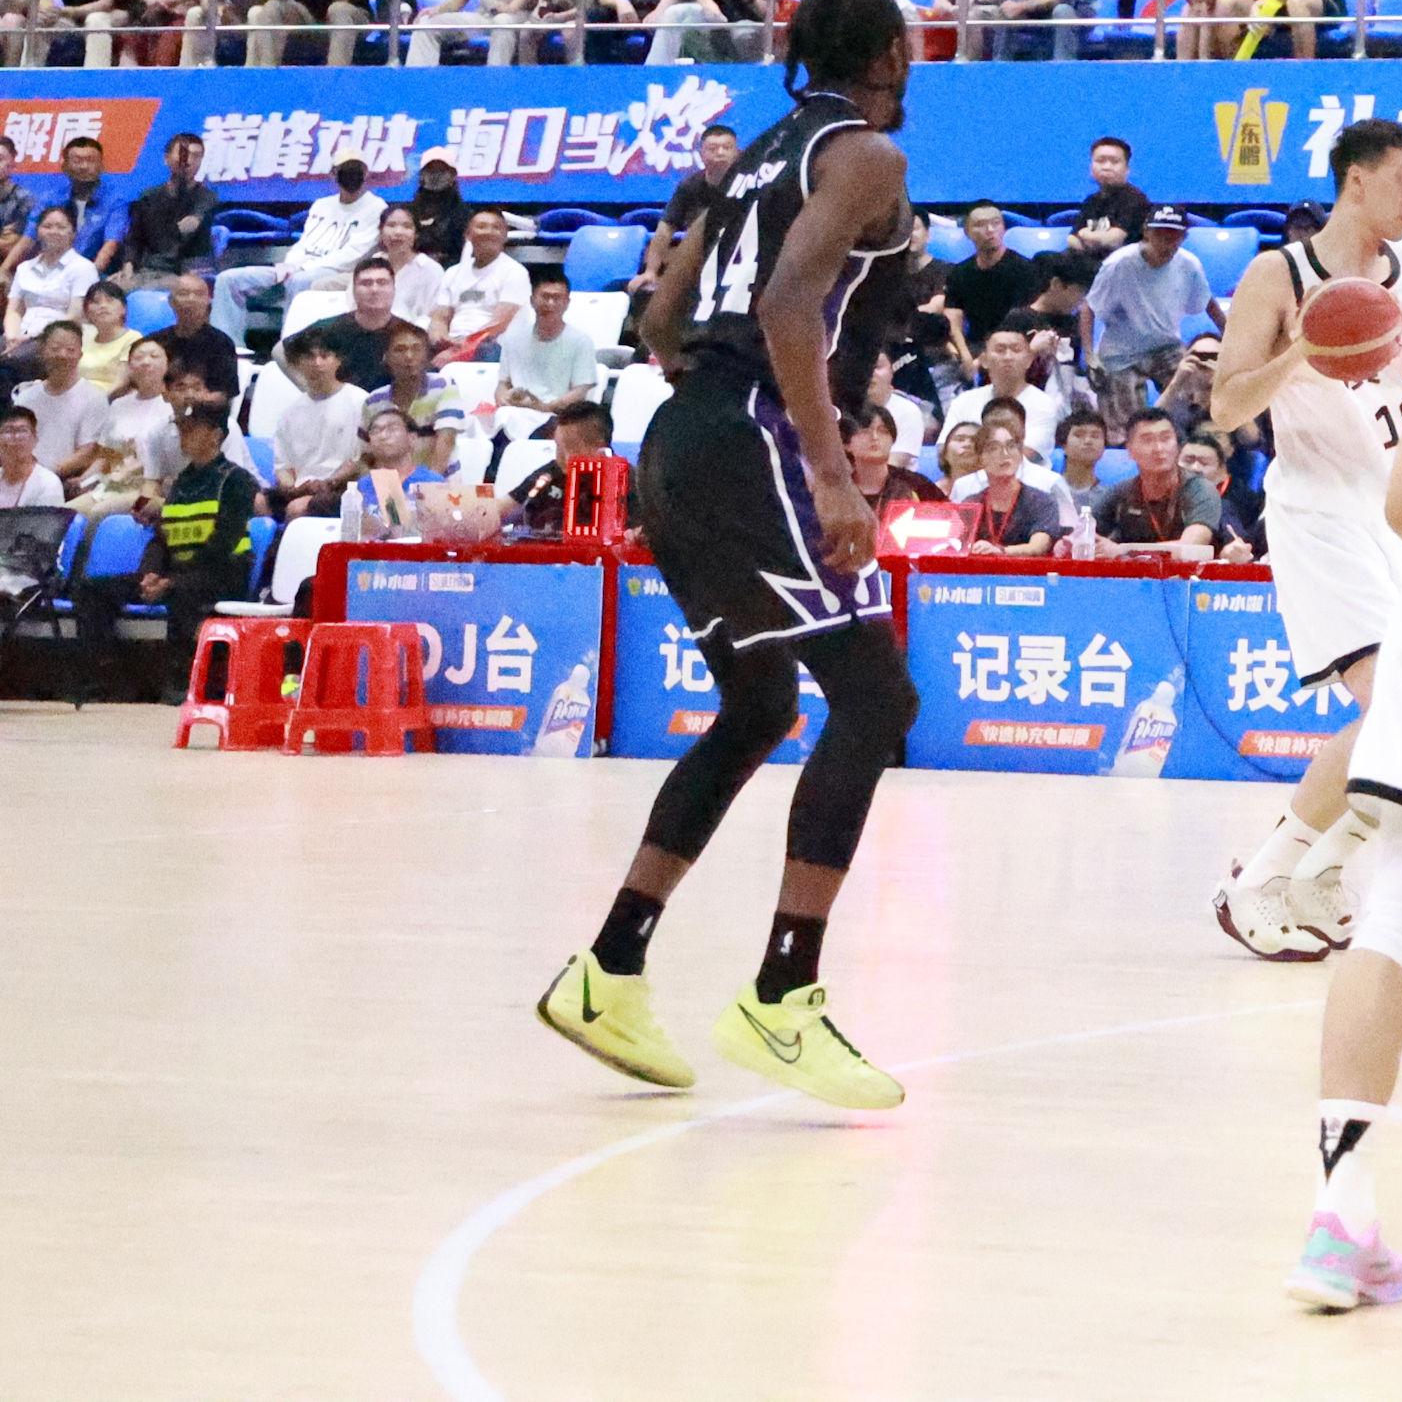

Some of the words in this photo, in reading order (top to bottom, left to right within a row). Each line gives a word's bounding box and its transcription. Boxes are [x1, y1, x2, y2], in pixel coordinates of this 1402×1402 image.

[196, 109, 417, 182] 巅峰对决
[694, 200, 759, 320] 14
[952, 631, 1133, 708] 记录台
